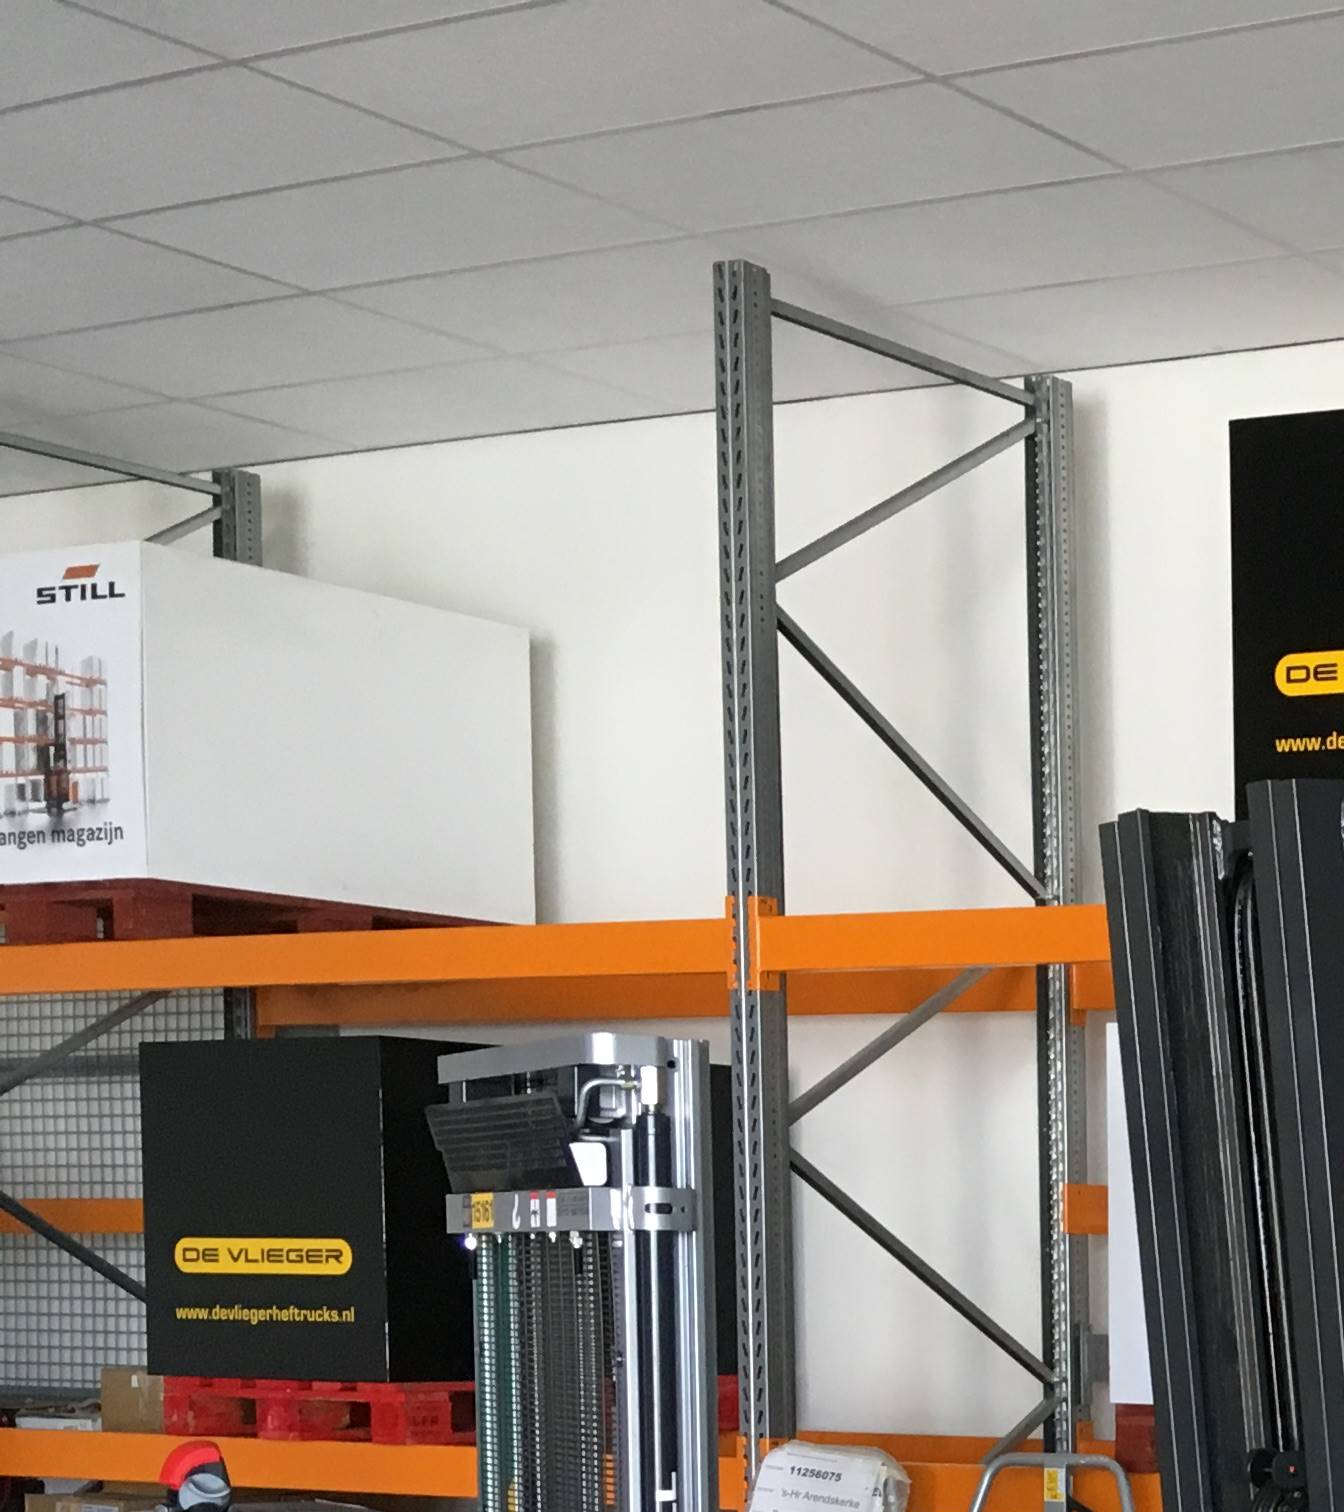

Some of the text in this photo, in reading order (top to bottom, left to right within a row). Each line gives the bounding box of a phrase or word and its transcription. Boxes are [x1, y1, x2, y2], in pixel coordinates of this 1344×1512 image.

[36, 581, 126, 605] STILL
[1285, 664, 1338, 684] DE
[51, 821, 124, 847] magazijn
[182, 1247, 344, 1264] DE VLIEGER
[175, 1304, 355, 1325] www.devliegerheftrucks.nl
[789, 1465, 843, 1482] 11256075
